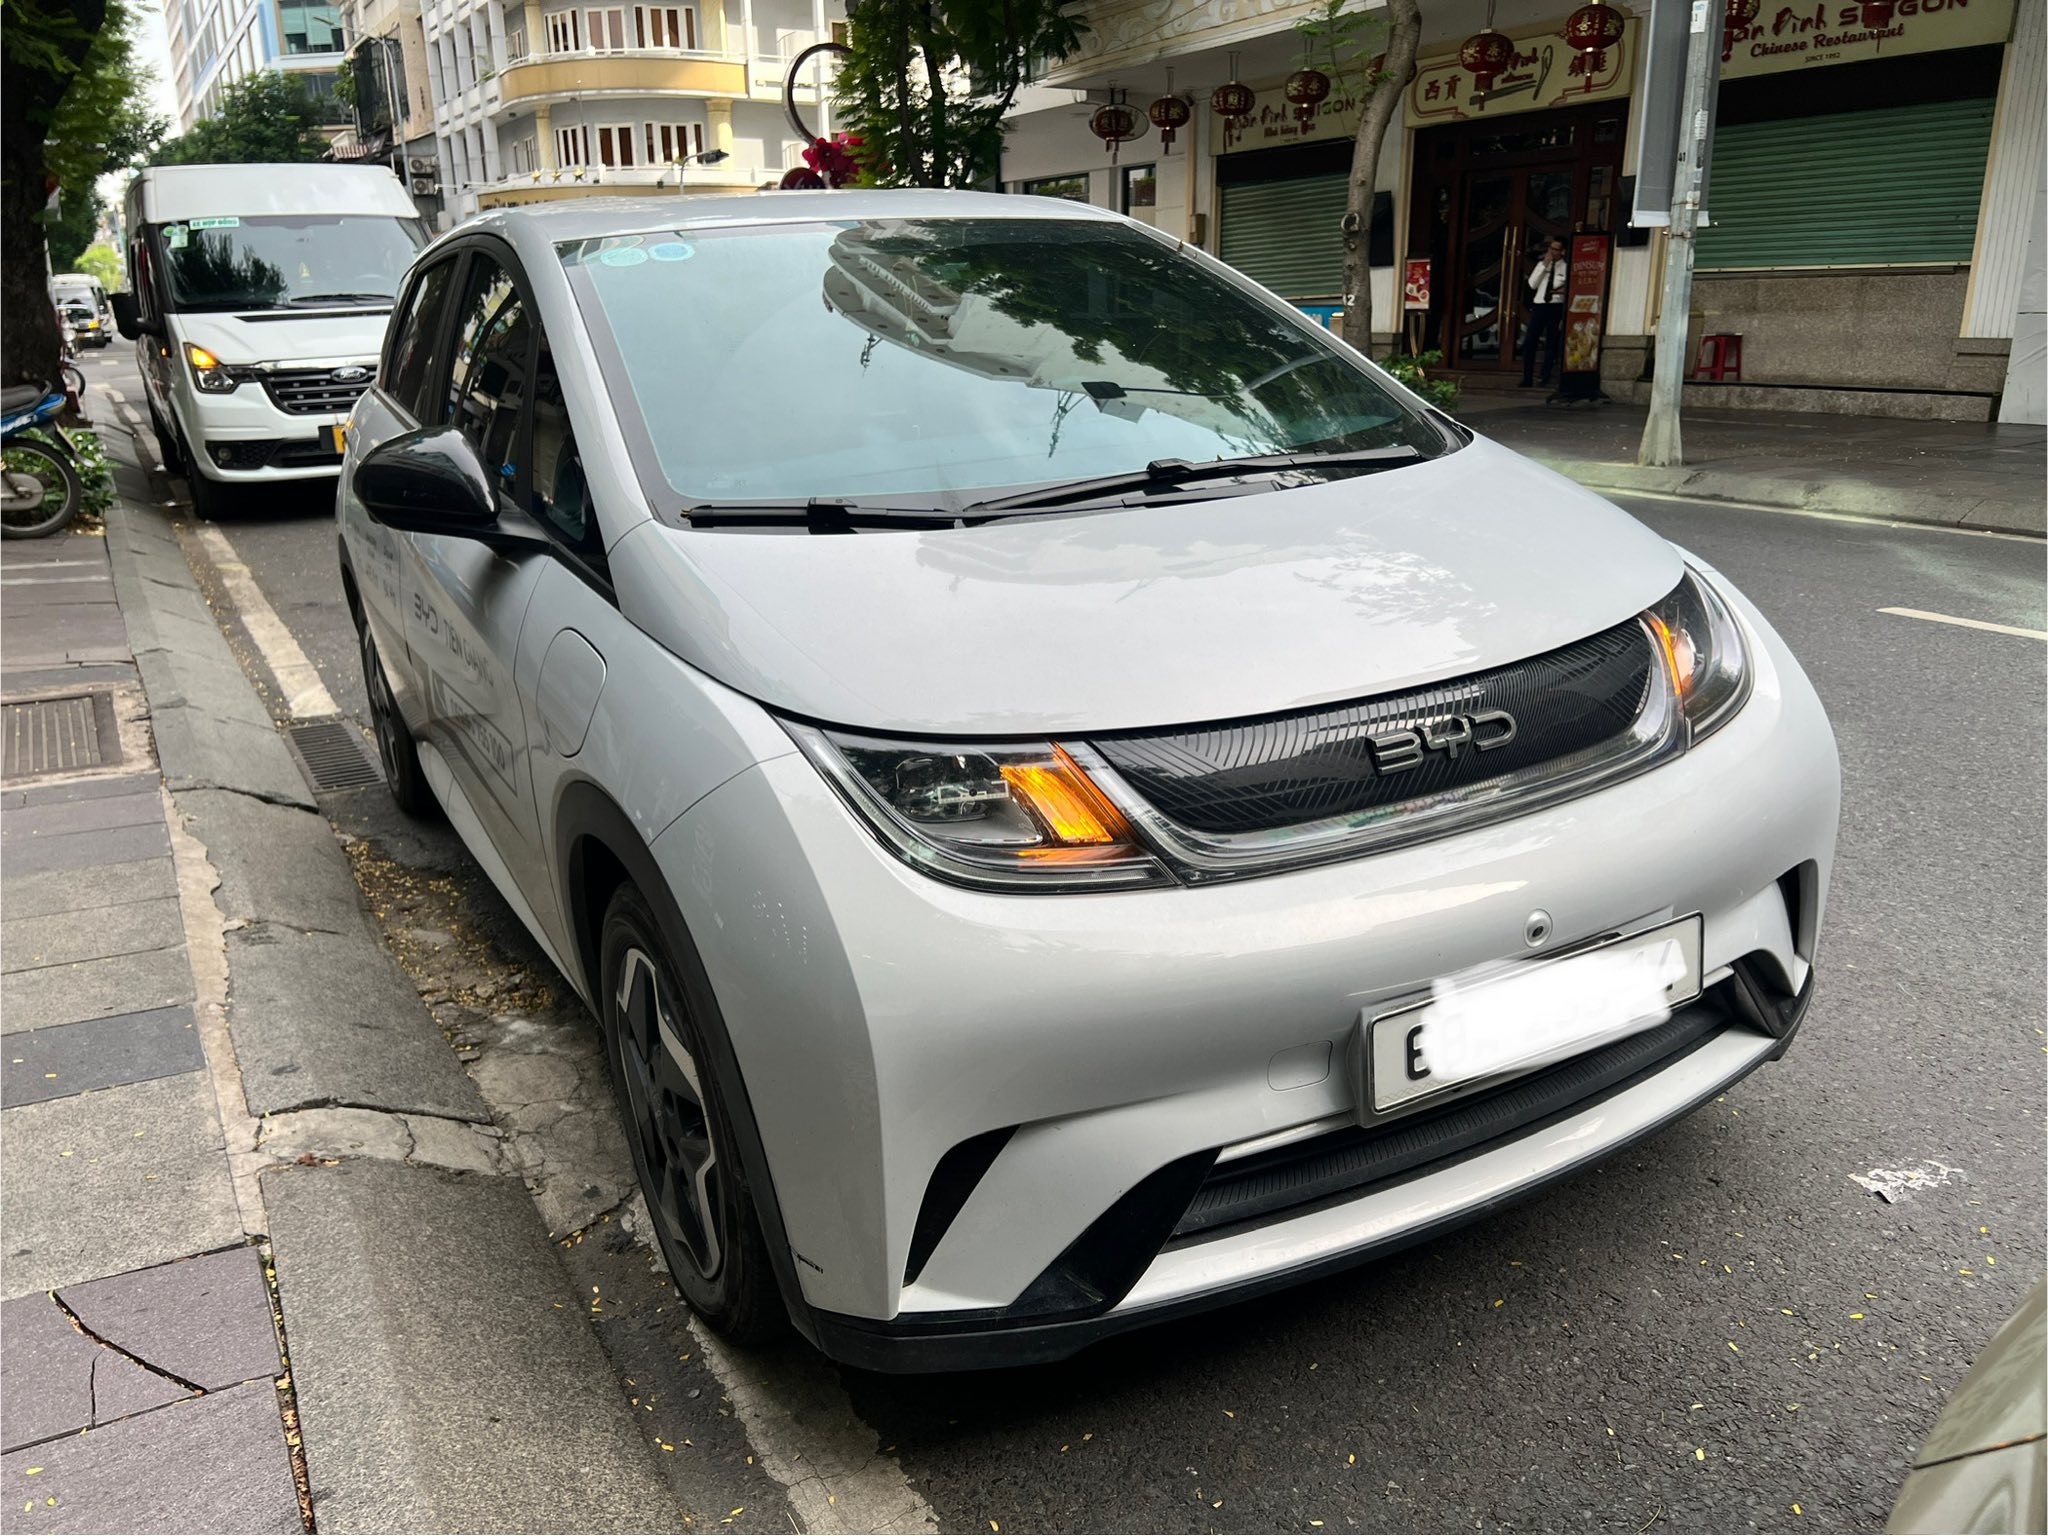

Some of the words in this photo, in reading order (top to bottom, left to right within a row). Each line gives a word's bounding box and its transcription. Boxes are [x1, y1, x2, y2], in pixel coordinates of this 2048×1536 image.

[1751, 39, 1808, 58] Chinese
[1813, 23, 1905, 50] Restaurant
[414, 591, 439, 635] BYD
[1365, 709, 1518, 777] BYD
